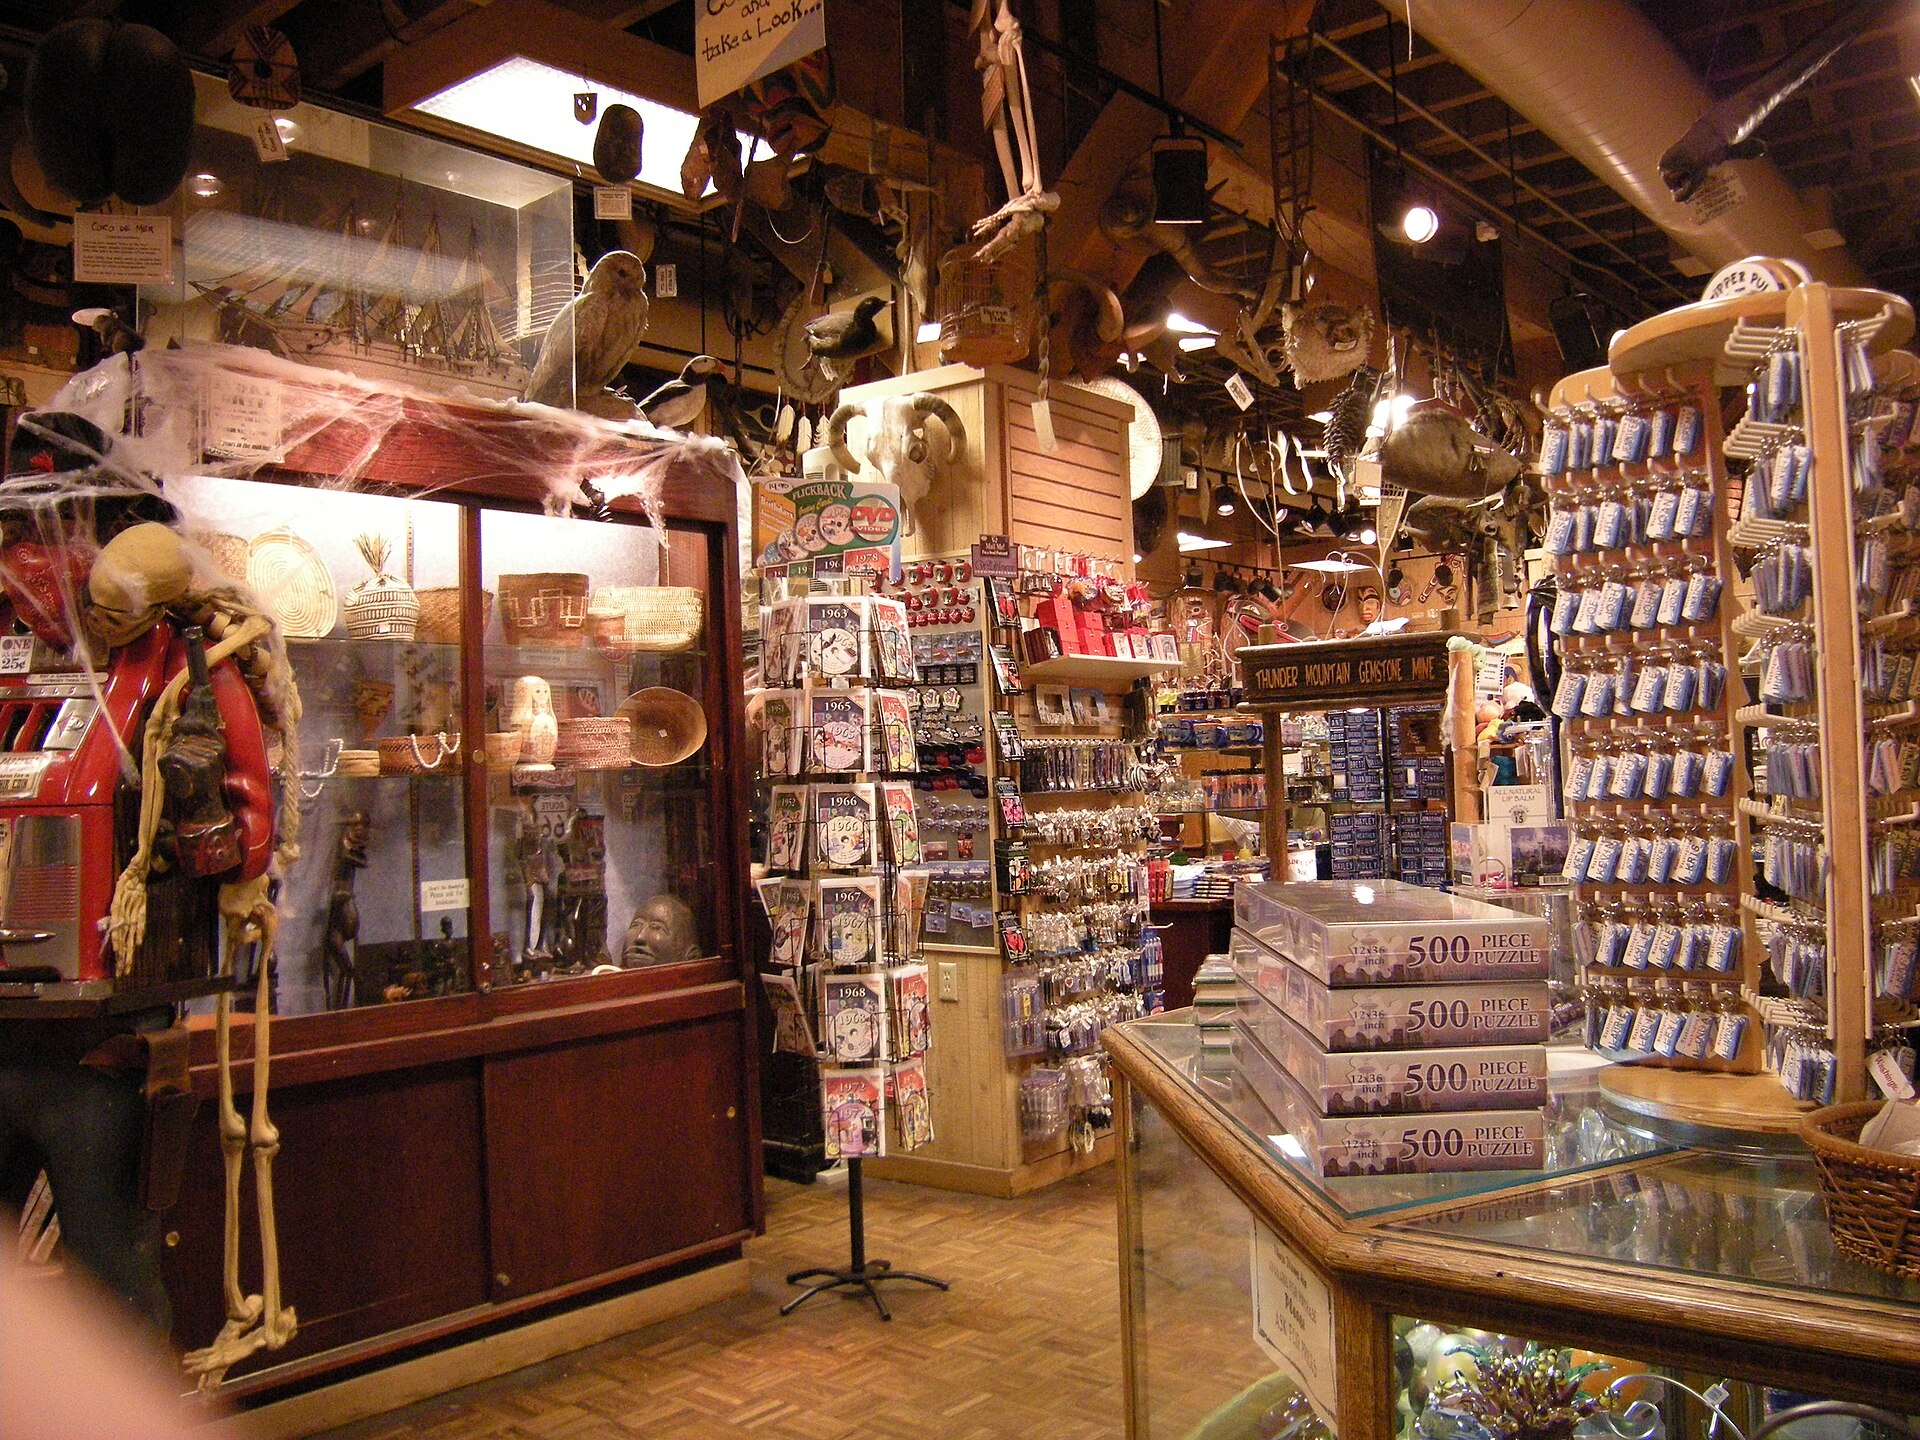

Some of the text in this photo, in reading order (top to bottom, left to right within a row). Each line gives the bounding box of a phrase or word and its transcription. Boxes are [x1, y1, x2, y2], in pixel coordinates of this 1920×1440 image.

[702, 35, 739, 62] take
[741, 30, 752, 42] a
[1750, 272, 1769, 292] PUL
[1544, 430, 1560, 466] JASON
[792, 483, 847, 500] FLICKBACK
[850, 506, 897, 524] DVD
[1656, 498, 1673, 529] JOAN
[1680, 493, 1696, 528] JOANNE
[1550, 513, 1568, 547] JESSE
[855, 553, 878, 563] 1978
[1604, 588, 1621, 618] JOSH
[1641, 588, 1658, 618] JOHN
[1667, 588, 1680, 612] JON
[821, 608, 848, 619] 1963
[1584, 600, 1598, 621] JOE
[1, 658, 26, 672] 25¢
[1255, 656, 1435, 690] THUNDER MOUNTAIN GEMSTONE MINE
[1560, 674, 1579, 712] STEPHEN
[1588, 679, 1606, 709] JOSE
[1668, 667, 1687, 703] JUSTIN
[824, 701, 851, 712] 1965
[1571, 759, 1591, 797] KAREN
[1617, 757, 1636, 794] KATHY
[830, 796, 857, 807] 1966
[831, 821, 859, 832] 1966
[1514, 815, 1524, 824] 15
[1406, 861, 1418, 869] JOE
[1570, 846, 1588, 871] KEN
[1594, 840, 1614, 876] KEVIN
[1684, 843, 1701, 872] KRIS
[834, 891, 861, 902] 1967
[1353, 945, 1386, 955] 12x36
[1408, 933, 1531, 967] 500 PIECE
[1631, 927, 1652, 964] KYLIE
[1712, 928, 1730, 966] LAURA
[1364, 956, 1385, 965] inch
[1473, 949, 1540, 965] PUZZLE
[839, 987, 866, 998] 1968
[1353, 1010, 1385, 1020] 12x36
[1407, 998, 1530, 1032] 500 PIECE
[1472, 1013, 1539, 1029] PUZZLE
[1364, 1021, 1385, 1030] inch
[1608, 1012, 1627, 1046] LAURIE
[1636, 1011, 1656, 1048] LESLIE
[839, 1083, 866, 1093] 1972
[1350, 1073, 1383, 1083] 12x36
[1405, 1061, 1528, 1096] 500 PIECE
[1470, 1077, 1537, 1092] PUZZLE
[1362, 1084, 1383, 1094] inch
[1346, 1139, 1379, 1149] 12x36
[1401, 1126, 1524, 1161] 500 PIECE
[1466, 1141, 1533, 1157] PUZZLE
[1357, 1149, 1378, 1159] inch
